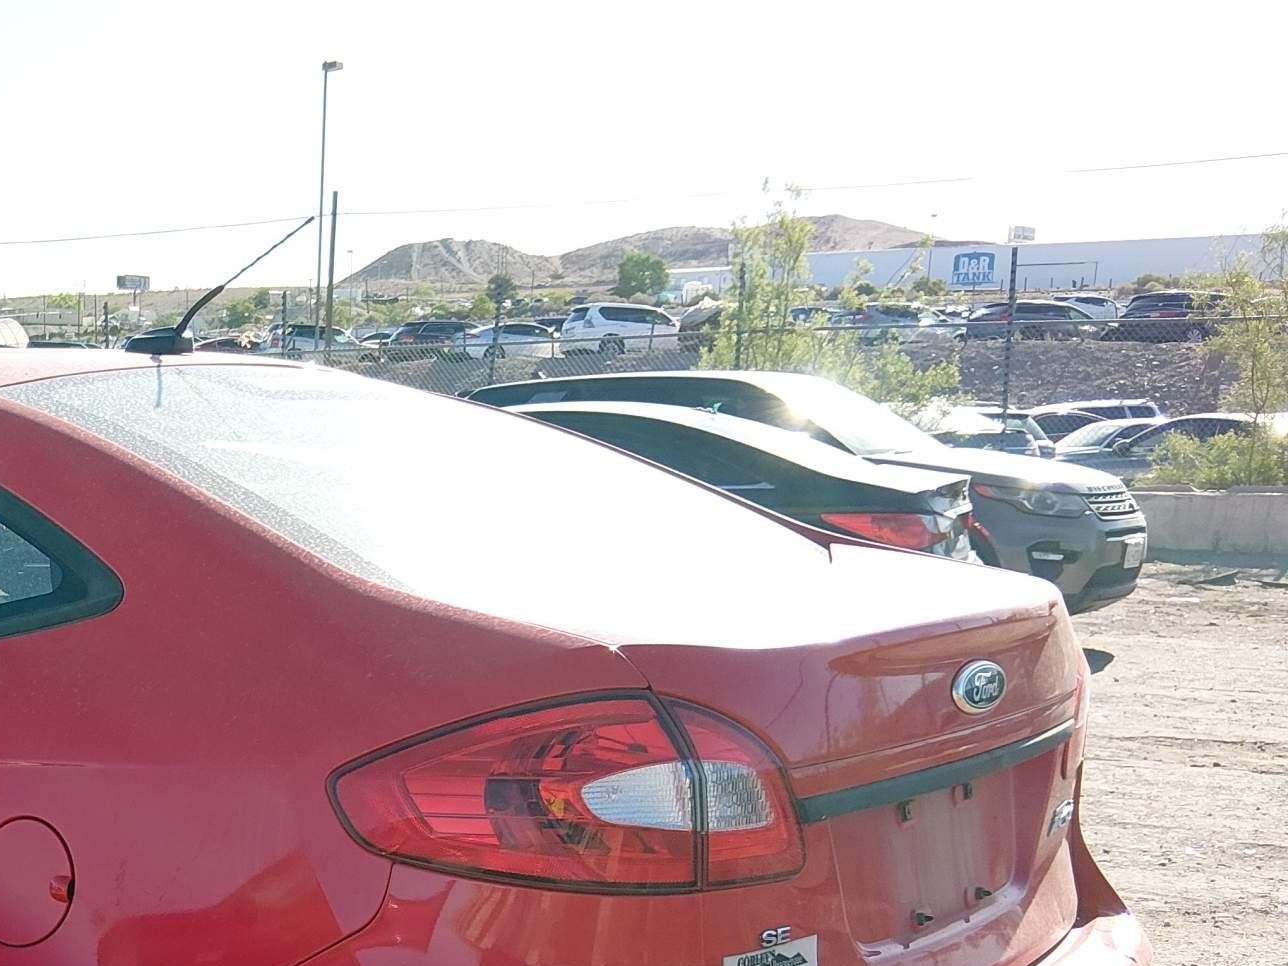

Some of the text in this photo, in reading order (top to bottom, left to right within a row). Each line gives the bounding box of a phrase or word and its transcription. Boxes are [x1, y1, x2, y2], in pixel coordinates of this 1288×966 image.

[959, 255, 990, 272] D&R
[953, 271, 993, 283] TANK
[973, 672, 1000, 700] Ford
[760, 925, 792, 948] SE
